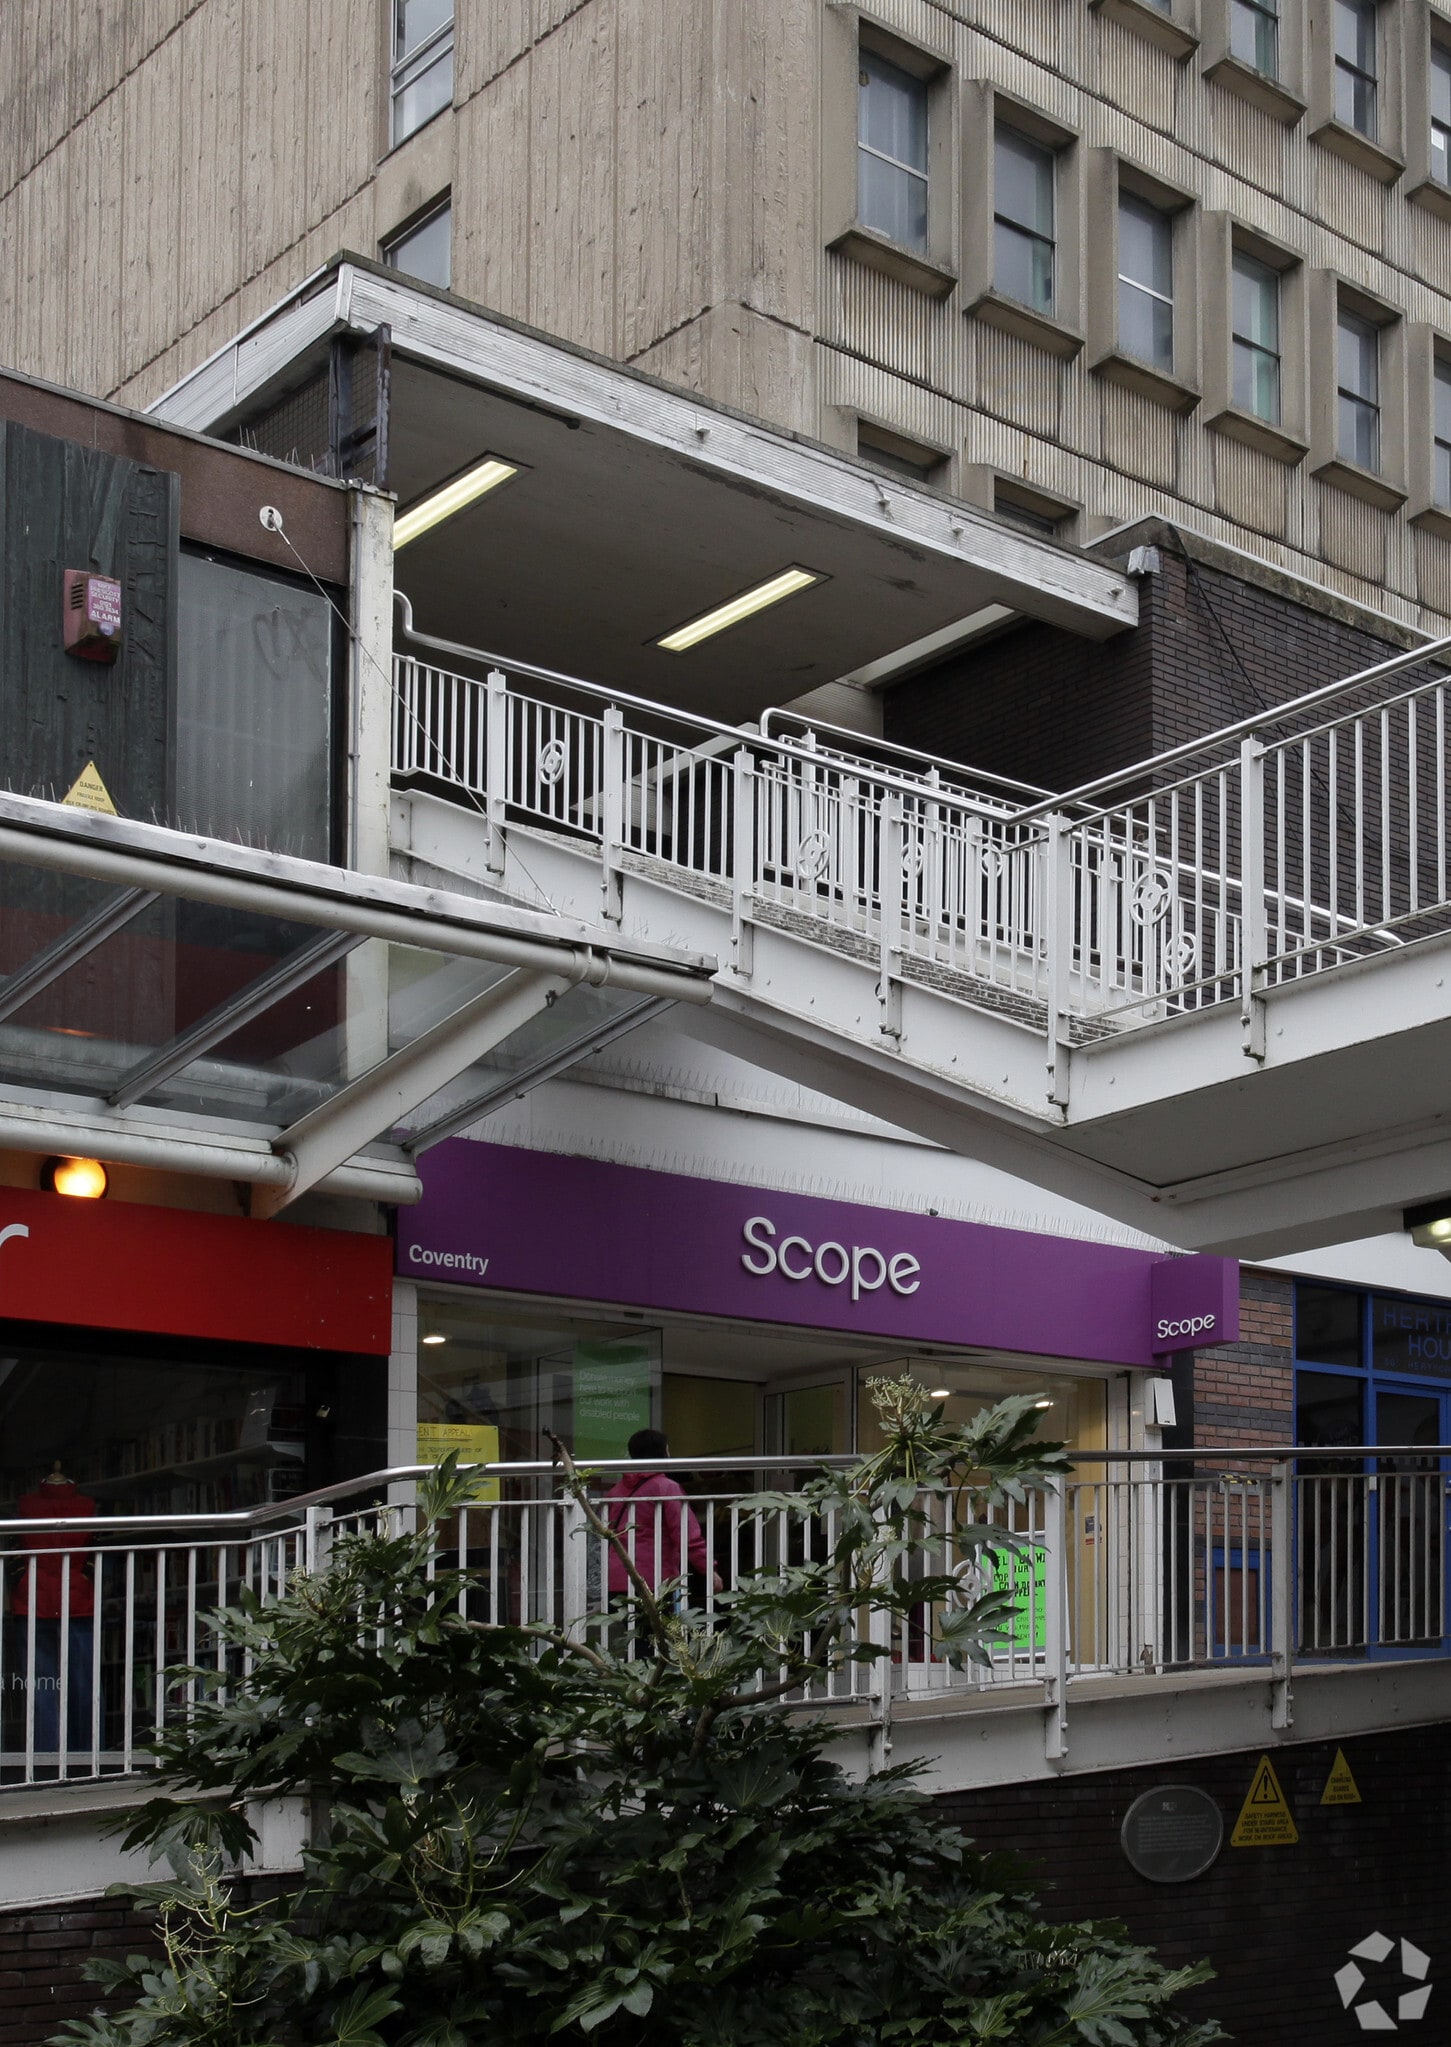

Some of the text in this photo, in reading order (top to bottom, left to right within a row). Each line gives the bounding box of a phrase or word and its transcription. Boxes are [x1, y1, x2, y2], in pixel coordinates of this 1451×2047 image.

[91, 610, 120, 624] ALARM
[79, 781, 104, 792] DANGER
[409, 1244, 489, 1276] Coventry
[741, 1216, 921, 1301] Scope
[1157, 1314, 1216, 1339] Scope
[593, 1397, 613, 1406] work
[613, 1399, 630, 1408] with
[579, 1408, 640, 1422] disabled people
[1263, 1811, 1286, 1819] HARNESS
